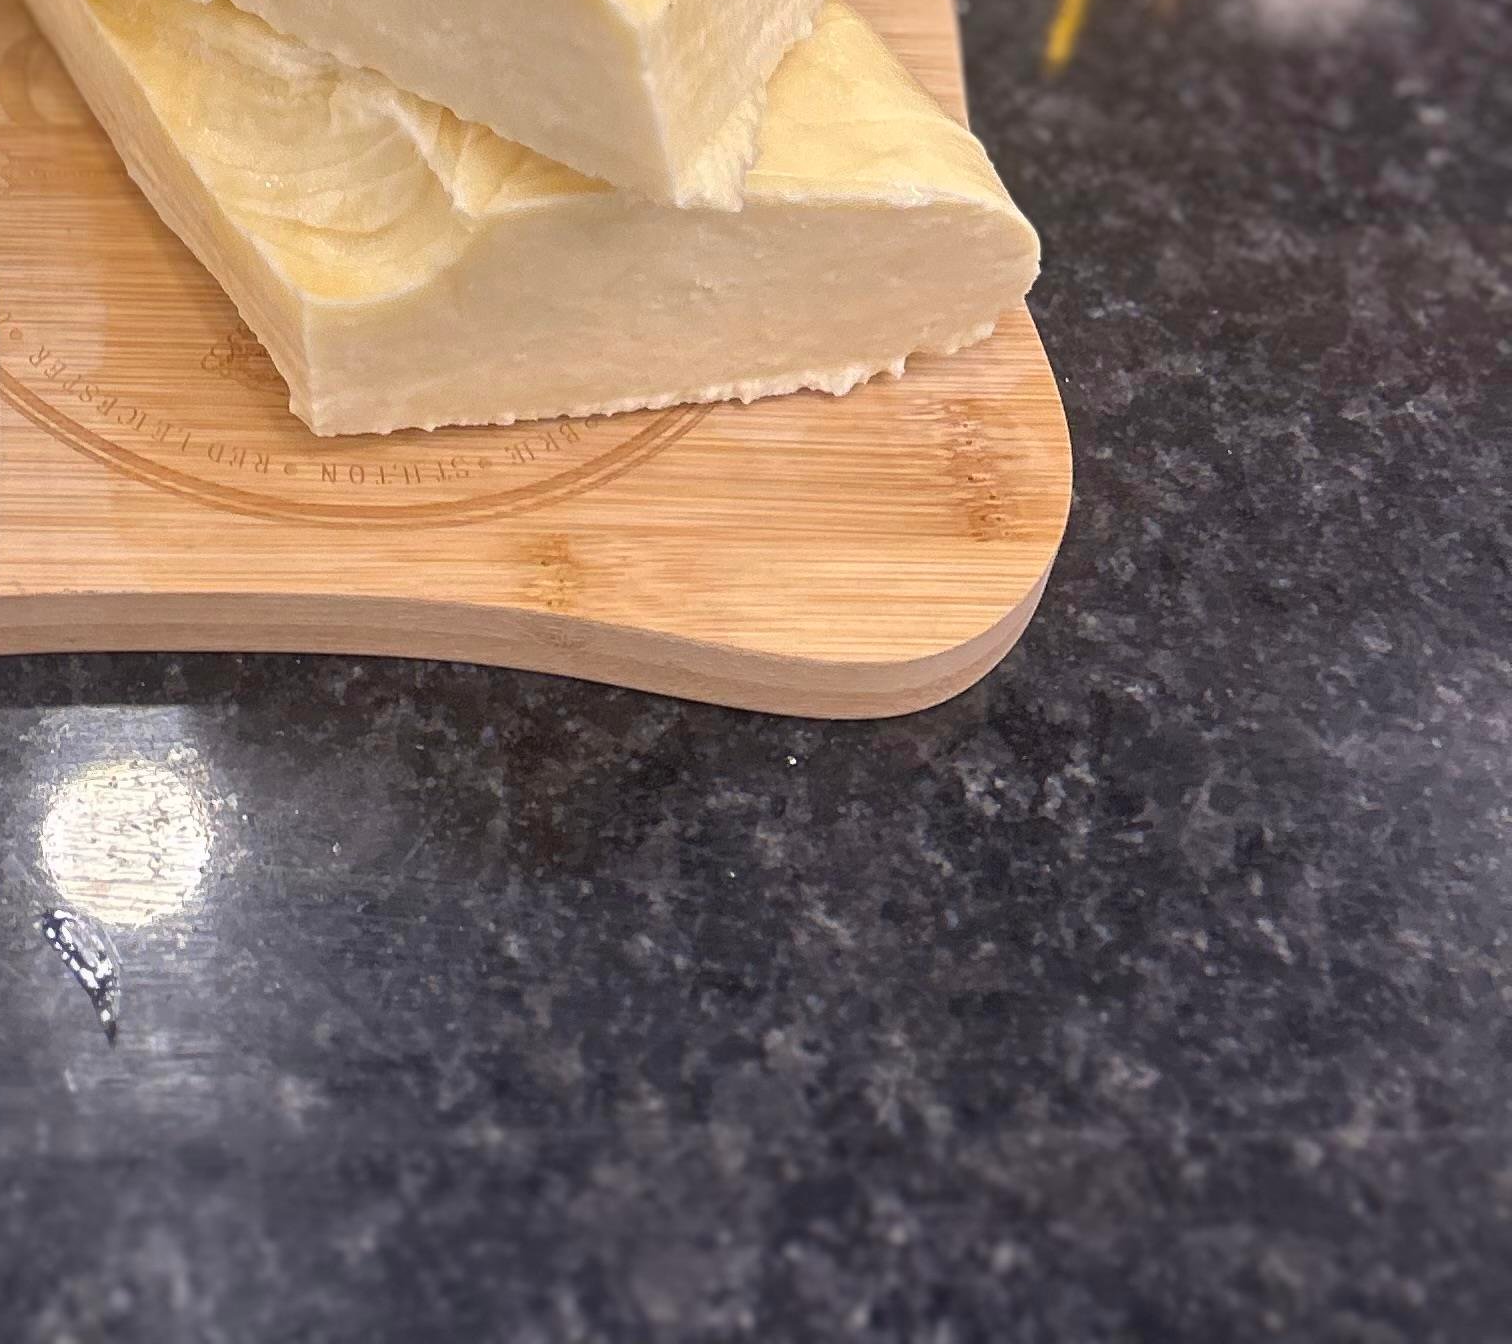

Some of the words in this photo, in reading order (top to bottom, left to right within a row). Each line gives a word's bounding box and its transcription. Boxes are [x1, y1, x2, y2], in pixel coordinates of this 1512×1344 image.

[207, 442, 270, 474] RED
[504, 421, 581, 464] BRIE
[321, 456, 470, 485] STILTON
